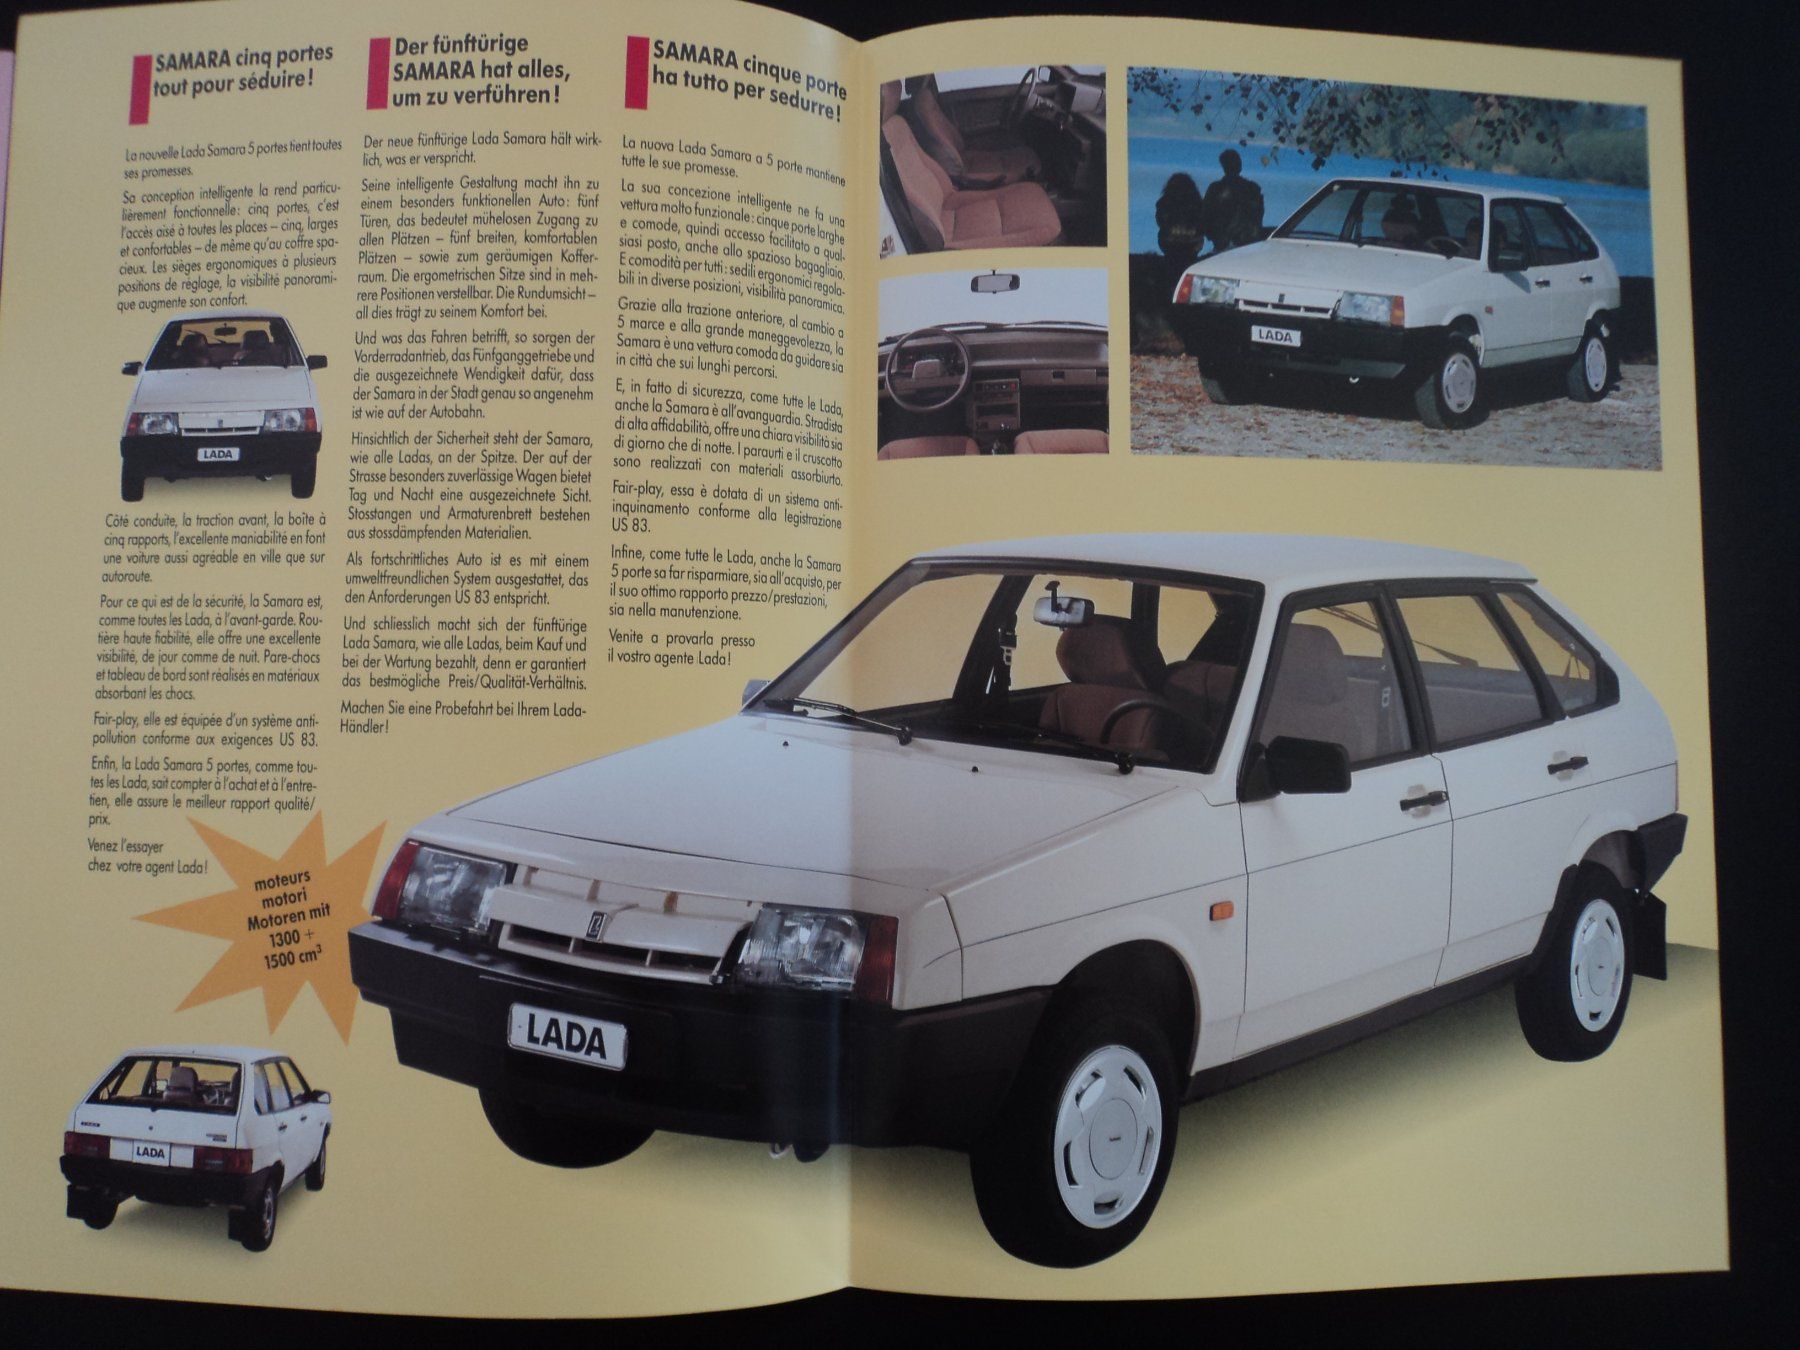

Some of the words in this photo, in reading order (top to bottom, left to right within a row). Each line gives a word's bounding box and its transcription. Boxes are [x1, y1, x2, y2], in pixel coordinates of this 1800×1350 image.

[395, 37, 429, 56] Der
[432, 32, 529, 57] fünftürige
[155, 48, 231, 72] SAMARA
[235, 47, 272, 69] cinq
[276, 44, 333, 68] portes
[392, 60, 476, 82] SAMARA
[480, 60, 513, 78] hat
[653, 39, 739, 70] SAMARA
[743, 54, 801, 84] cinque
[805, 74, 847, 101] porte
[153, 78, 188, 96] tout
[191, 78, 235, 99] pour
[652, 63, 678, 86] ha
[682, 70, 729, 92] tutto
[733, 80, 766, 99] per
[392, 92, 421, 107] um
[426, 90, 448, 105] zu
[124, 148, 138, 162] La
[138, 145, 179, 161] nouvelle
[180, 143, 205, 158] Lada
[206, 143, 246, 157] Samara
[247, 140, 255, 155] 5
[255, 141, 288, 158] portes
[289, 139, 311, 152] tient
[311, 138, 342, 151] toutes
[363, 134, 384, 148] Der
[387, 137, 414, 147] neue
[416, 133, 468, 152] fünftürige
[471, 132, 499, 145] Lada
[502, 132, 546, 145] Samara
[550, 131, 572, 146] hält
[622, 134, 636, 149] La
[639, 140, 674, 152] nuova
[678, 138, 706, 156] Lada
[710, 143, 752, 162] Samara
[755, 154, 763, 164] a
[766, 152, 774, 166] 5
[776, 159, 803, 173] porte
[805, 166, 846, 187] mantiene
[122, 189, 136, 204] Sa
[140, 187, 194, 205] conception
[199, 184, 253, 203] intelligente
[258, 182, 268, 197] la
[273, 181, 298, 196] rend
[396, 213, 416, 227] das
[420, 213, 468, 226] bedeutet
[472, 212, 531, 225] mühelosen
[536, 212, 580, 231] Zugang
[584, 216, 598, 227] zu
[619, 198, 658, 212] vettura
[660, 199, 692, 215] molto
[756, 211, 790, 231] cinque
[790, 222, 816, 236] porte
[816, 224, 845, 245] larghe
[1258, 328, 1293, 344] LADA
[615, 351, 626, 365] in
[629, 352, 653, 367] città
[655, 353, 676, 368] che
[678, 355, 694, 369] sui
[697, 356, 731, 376] lunghi
[352, 367, 370, 382] die
[375, 367, 458, 386] ausgezeichnete
[463, 367, 525, 386] Wendigkeit
[569, 367, 594, 382] dass
[614, 397, 649, 412] anche
[651, 398, 662, 412] la
[665, 398, 709, 416] Samara
[711, 402, 719, 417] è
[804, 413, 843, 433] Stradista
[203, 449, 233, 460] LADA
[348, 468, 387, 482] Strasse
[388, 468, 445, 482] besonders
[446, 468, 514, 486] zuverlässige
[515, 469, 557, 487] Wagen
[559, 469, 592, 483] bietet
[348, 486, 367, 505] Tag
[373, 487, 394, 501] und
[400, 487, 434, 501] Nacht
[439, 487, 463, 501] eine
[468, 487, 556, 506] ausgezeichnete
[611, 517, 628, 532] US
[103, 532, 125, 549] cinq
[230, 530, 288, 544] maniabilité
[289, 534, 303, 544] en
[304, 530, 326, 544] font
[344, 589, 365, 603] den
[367, 589, 451, 608] Anforderungen
[454, 590, 471, 604] US
[474, 590, 490, 604] 83
[609, 582, 616, 596] il
[618, 586, 639, 597] suo
[640, 583, 677, 598] ottimo
[678, 587, 729, 603] rapporto
[97, 630, 120, 644] tière
[122, 630, 152, 644] haute
[195, 630, 215, 645] elle
[217, 630, 242, 644] offre
[245, 634, 265, 645] une
[268, 631, 321, 645] excellente
[608, 628, 643, 643] Venite
[650, 633, 659, 644] a
[665, 631, 714, 648] provarla
[720, 636, 756, 649] presso
[607, 648, 614, 662] il
[616, 650, 651, 663] vostro
[653, 651, 694, 668] agente
[91, 730, 136, 747] pollution
[141, 730, 190, 745] conforme
[195, 735, 215, 745] aux
[220, 731, 273, 750] exigences
[279, 731, 295, 747] US
[114, 793, 133, 807] elle
[136, 797, 169, 808] assure
[172, 794, 182, 808] le
[185, 794, 227, 809] meilleur
[230, 797, 271, 813] rapport
[87, 857, 112, 872] chez
[115, 860, 143, 873] votre
[144, 860, 175, 877] agent
[254, 870, 311, 892] moteurs
[261, 886, 308, 909] motori
[247, 910, 306, 931] Motoren
[309, 902, 331, 920] mit
[269, 929, 301, 948] 1300
[264, 951, 296, 970] 1500
[527, 1012, 607, 1060] LADA
[136, 1146, 165, 1159] LADA
